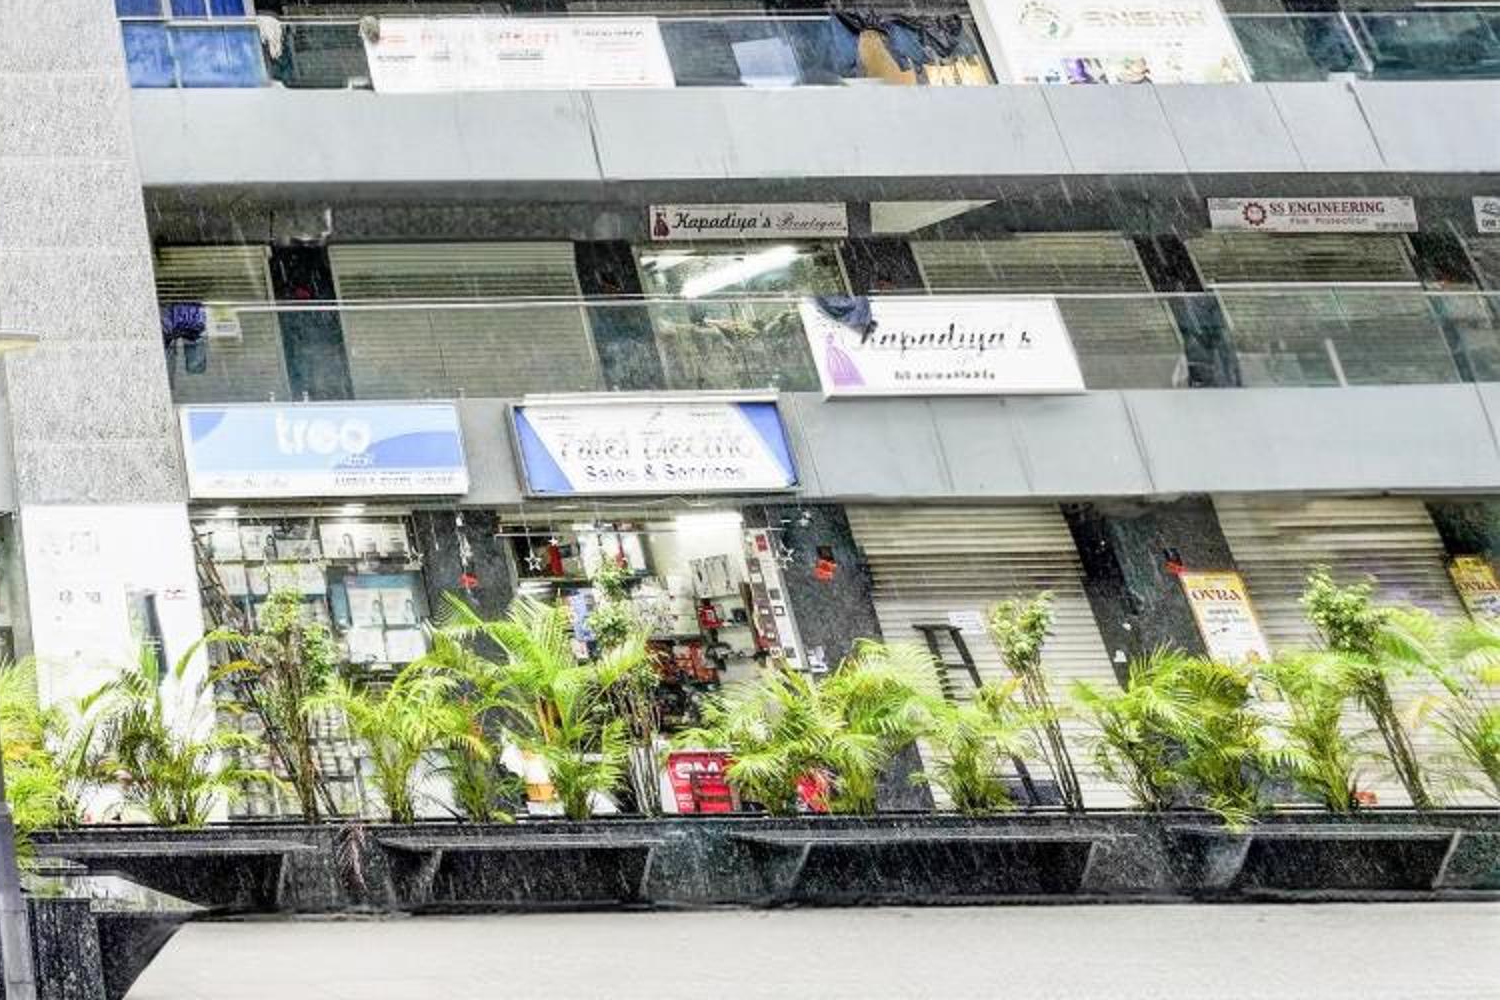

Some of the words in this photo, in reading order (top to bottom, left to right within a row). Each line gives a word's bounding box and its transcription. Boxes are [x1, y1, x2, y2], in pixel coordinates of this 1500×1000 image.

[1268, 201, 1288, 214] SS
[1289, 201, 1385, 214] ENGINEERING
[672, 210, 772, 232] Kapadiya's
